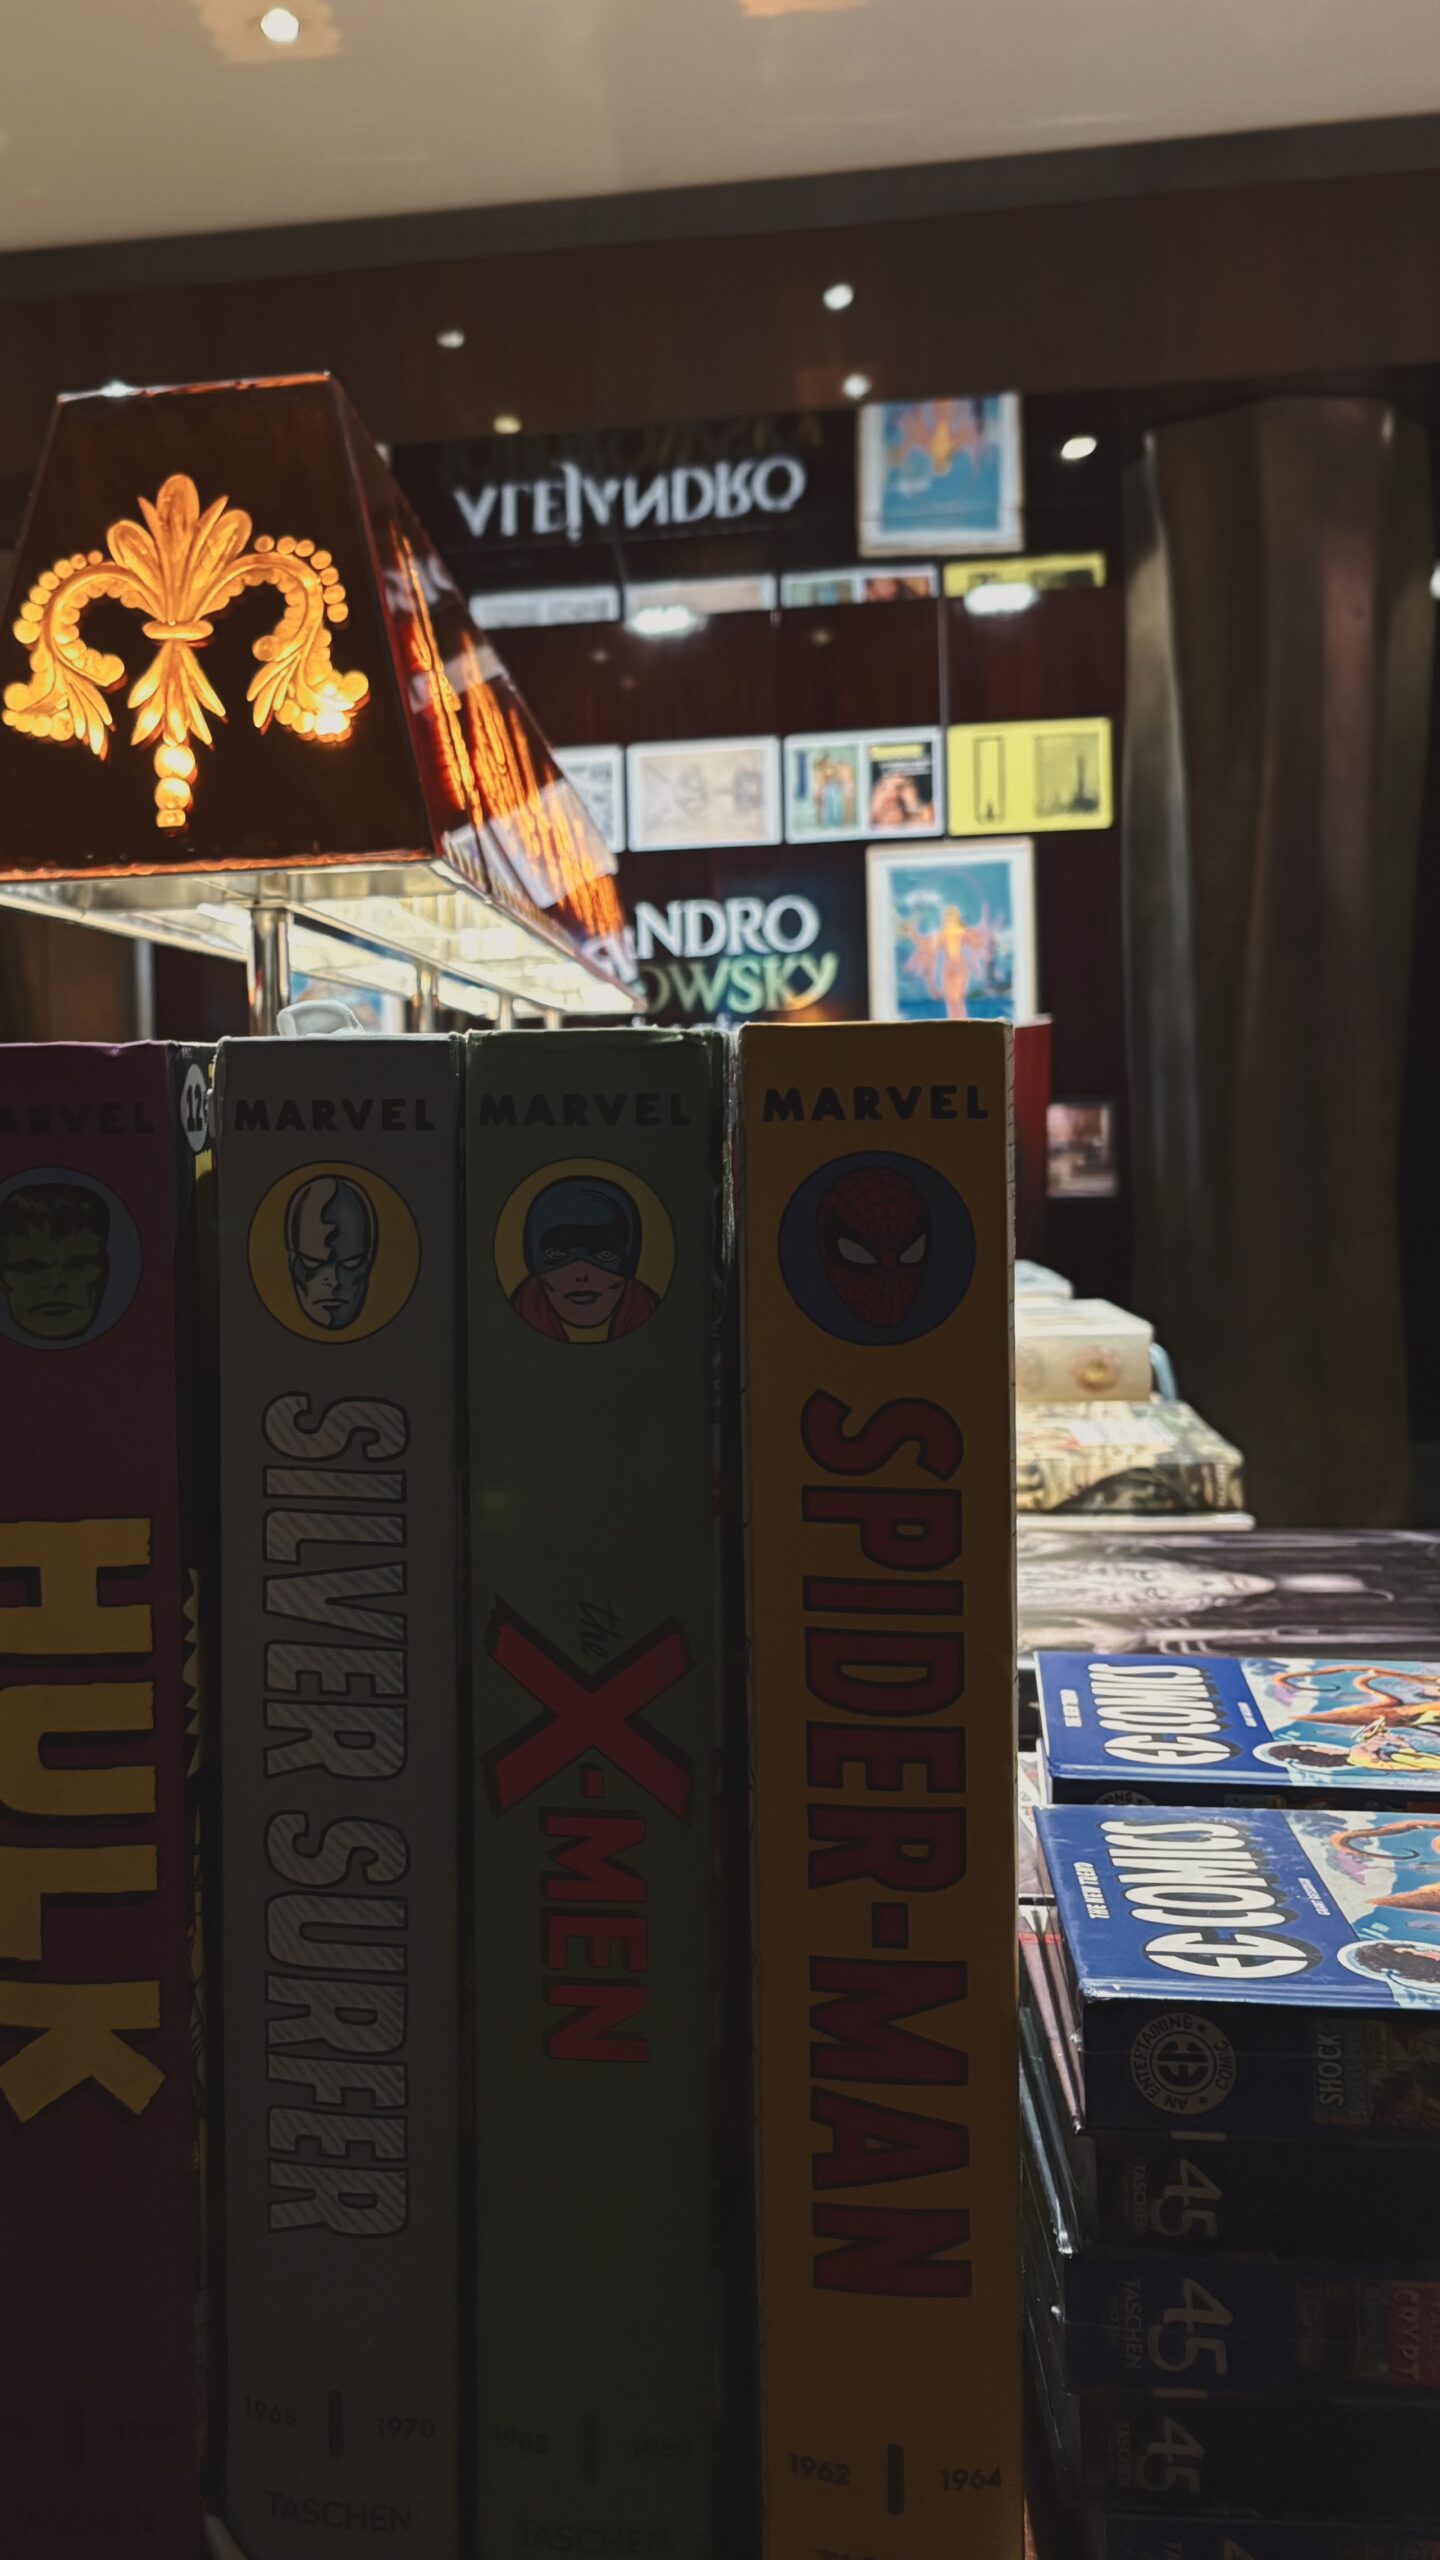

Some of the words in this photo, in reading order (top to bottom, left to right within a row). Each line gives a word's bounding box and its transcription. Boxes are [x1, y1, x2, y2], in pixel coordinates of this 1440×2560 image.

[234, 1098, 436, 1132] MARVEL
[478, 1092, 692, 1128] MARVEL
[762, 1084, 989, 1122] MARVEL
[262, 1393, 411, 1783] SILVER
[574, 1599, 624, 1660] the
[1087, 1663, 1222, 1734] COMICS
[0, 1517, 167, 2123] HULK
[479, 1592, 697, 2064] X-MEN
[800, 1388, 973, 2298] SPIDER-MAN
[1100, 1820, 1287, 1928] COMICS
[264, 1810, 411, 2238] SURFER
[1132, 2015, 1193, 2099] ENTERTAINING
[1164, 2096, 1189, 2111] AN
[1214, 2040, 1234, 2091] COMIC
[1316, 2032, 1344, 2107] SHOCK
[1151, 2158, 1223, 2239] 45
[1120, 2278, 1142, 2369] TASCHEN
[1147, 2277, 1235, 2376] 45
[1391, 2288, 1421, 2382] CRYPT
[786, 2451, 852, 2486] 1962
[941, 2464, 1003, 2491] 1964
[1134, 2416, 1206, 2494] 45
[263, 2487, 414, 2533] TASCHEN
